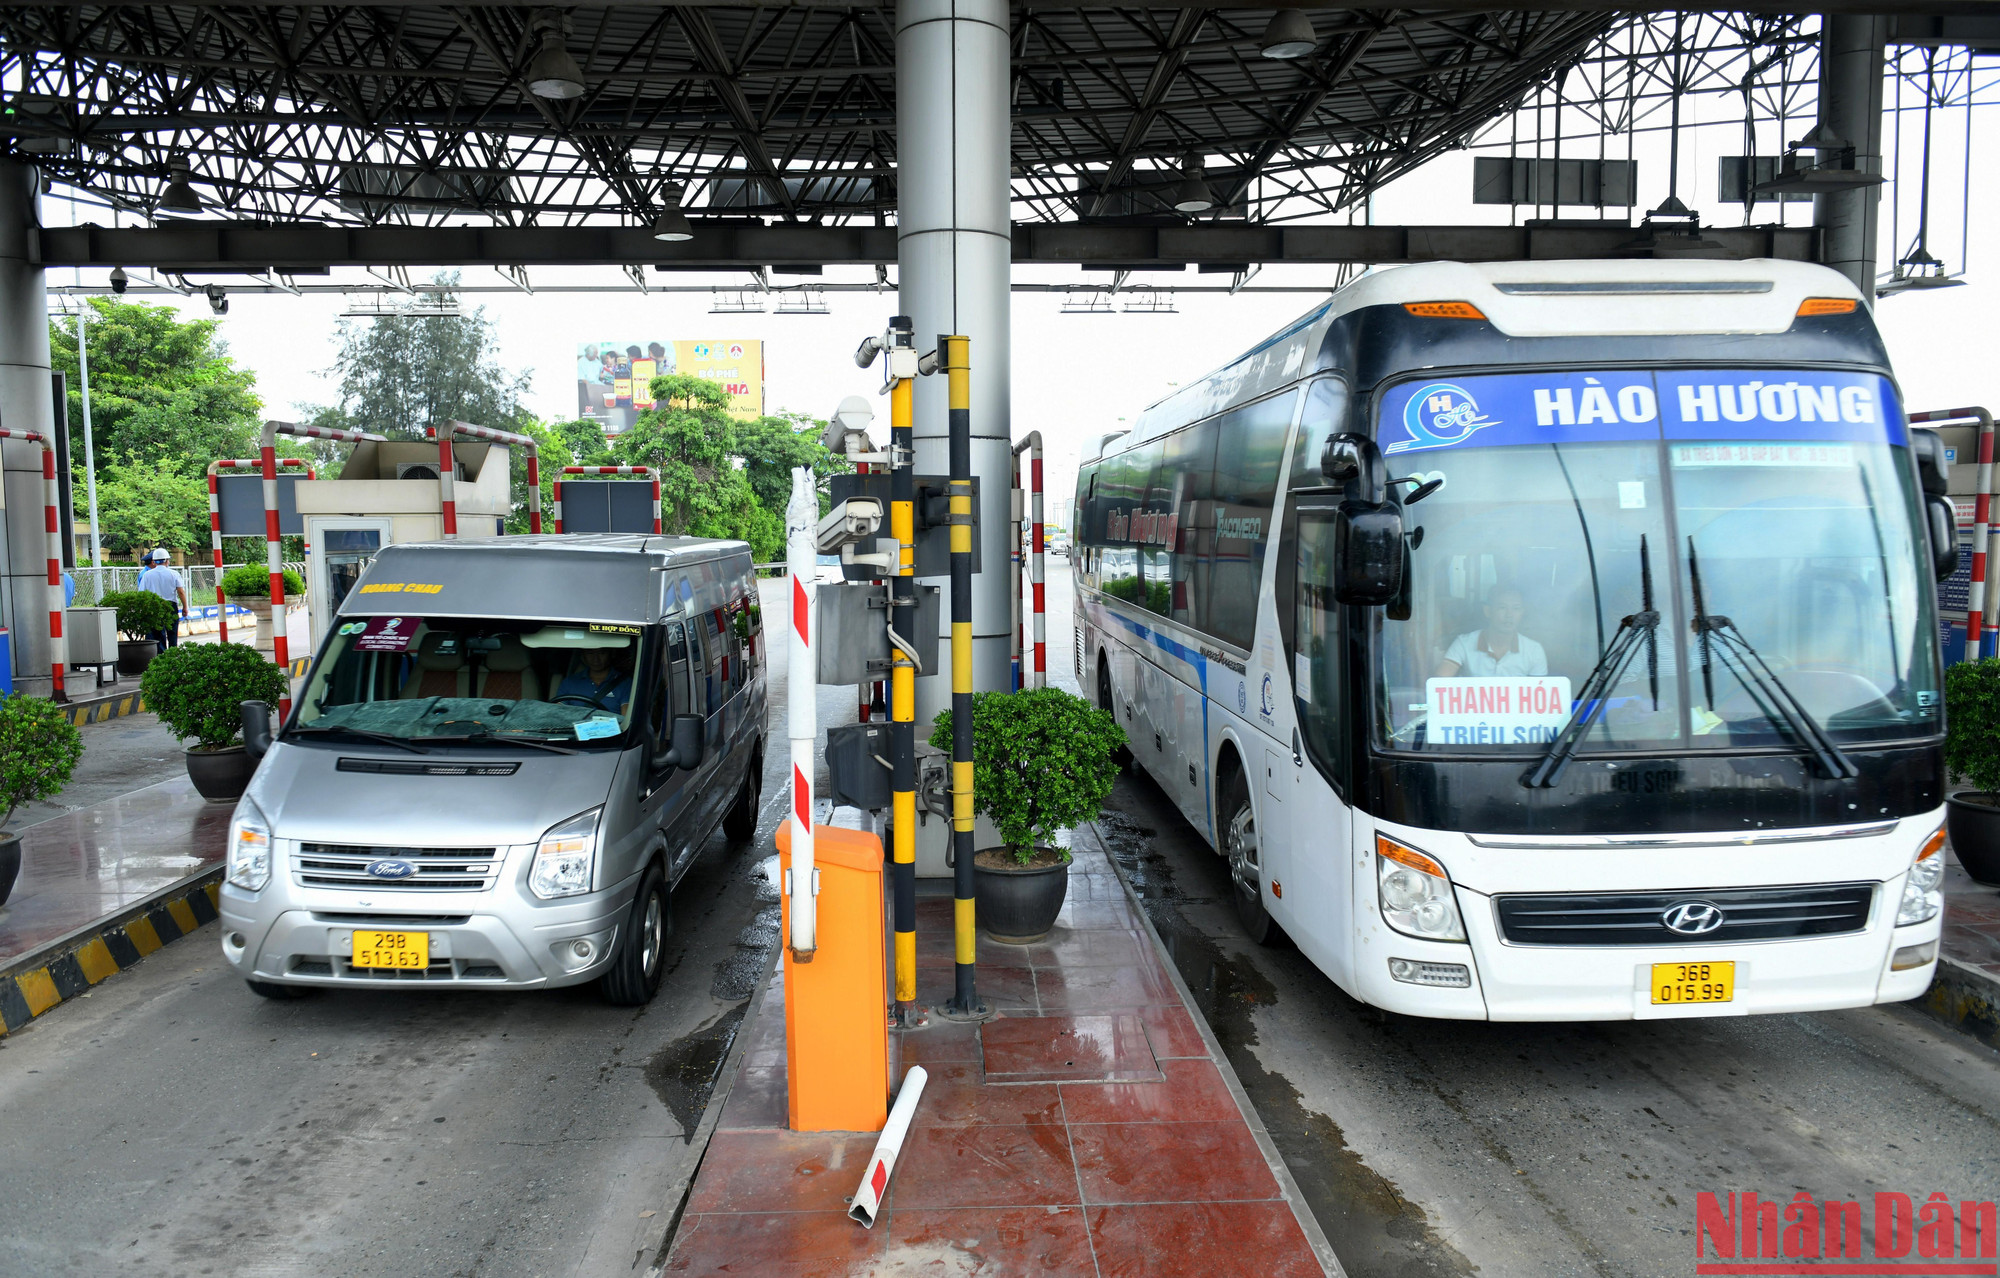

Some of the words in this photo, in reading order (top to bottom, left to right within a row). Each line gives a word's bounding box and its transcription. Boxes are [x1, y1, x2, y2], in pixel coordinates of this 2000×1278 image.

[1533, 378, 1658, 426] HÀO
[1677, 381, 1875, 423] HƯƠNG
[1435, 686, 1510, 714] THANH
[1519, 680, 1563, 714] HÓA
[374, 863, 405, 875] Ford
[375, 933, 406, 949] 29B
[361, 950, 419, 966] 513.63
[1677, 965, 1710, 981] 36B
[1662, 983, 1724, 1001] 015.99
